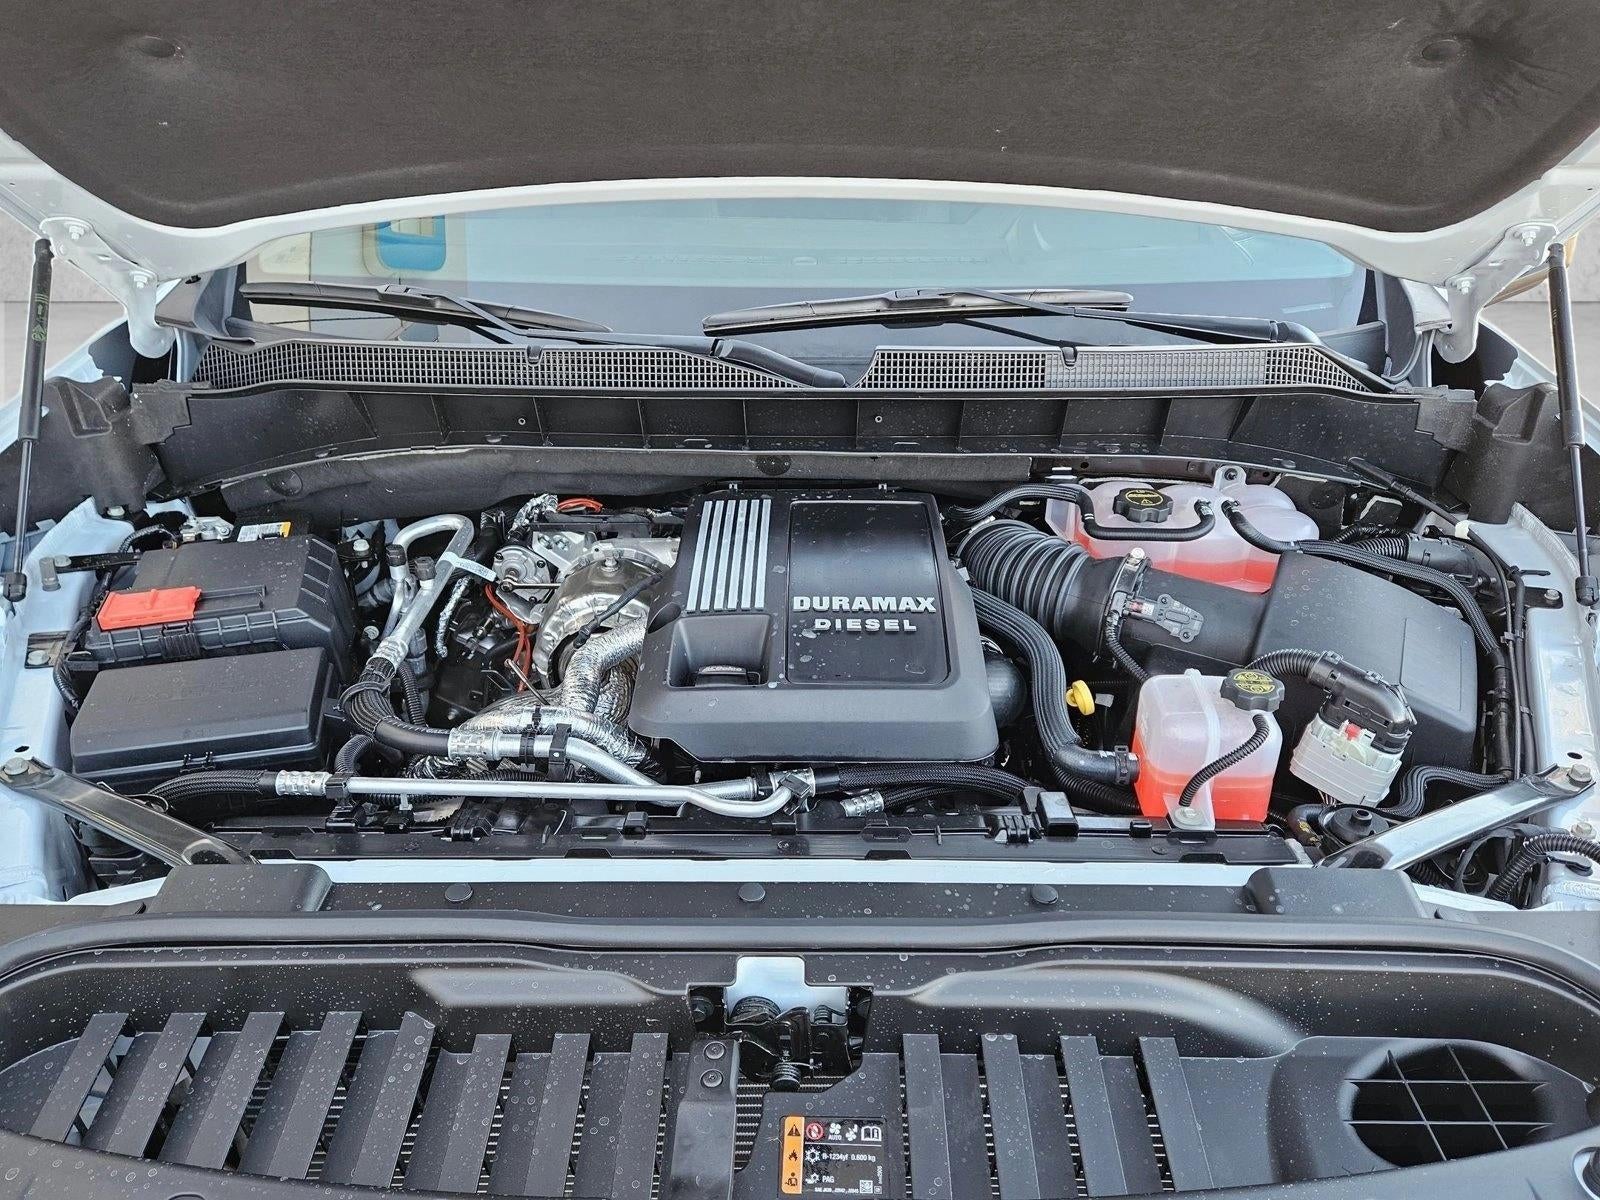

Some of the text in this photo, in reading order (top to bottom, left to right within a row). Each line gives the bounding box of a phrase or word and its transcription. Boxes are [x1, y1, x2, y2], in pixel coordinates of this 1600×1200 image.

[793, 596, 936, 612] DURAMAX
[814, 618, 917, 631] DIESEL
[822, 1175, 834, 1183] PAG
